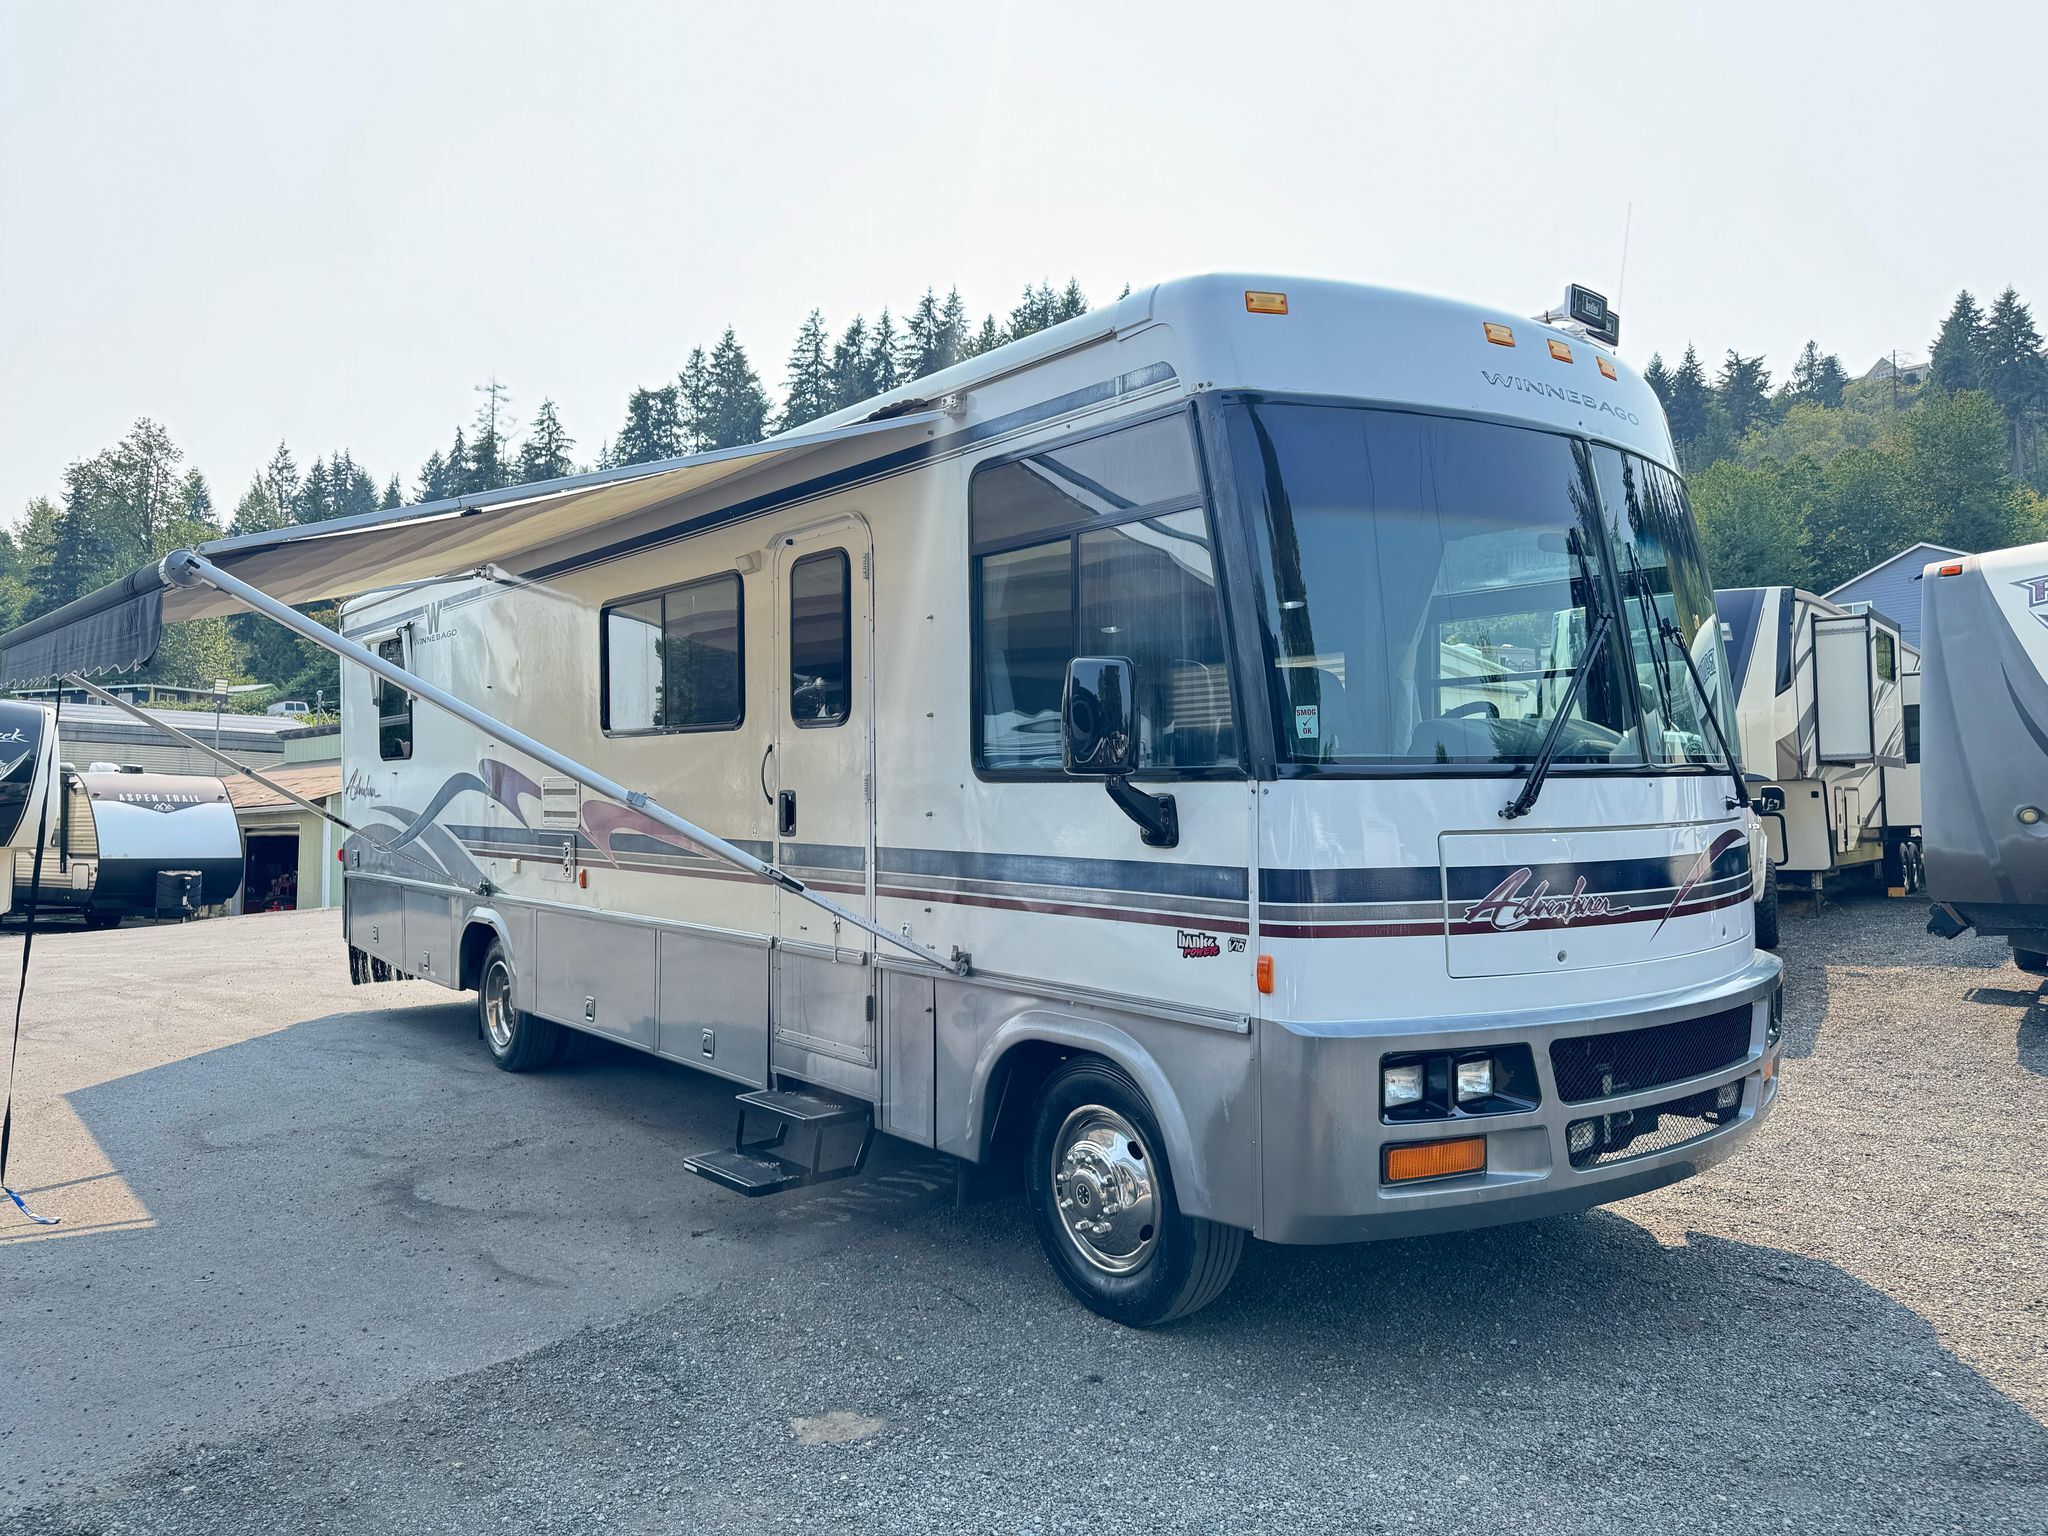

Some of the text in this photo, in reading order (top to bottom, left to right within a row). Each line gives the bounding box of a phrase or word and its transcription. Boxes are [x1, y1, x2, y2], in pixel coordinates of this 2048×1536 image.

[1481, 370, 1639, 426] WINNEBAGO
[1296, 708, 1317, 716] SMOG
[1302, 727, 1313, 735] OK
[118, 793, 201, 803] ASPEN TRAIL
[1464, 867, 1631, 931] Adventurer
[1183, 945, 1220, 958] POWER
[1228, 939, 1246, 952] V10
